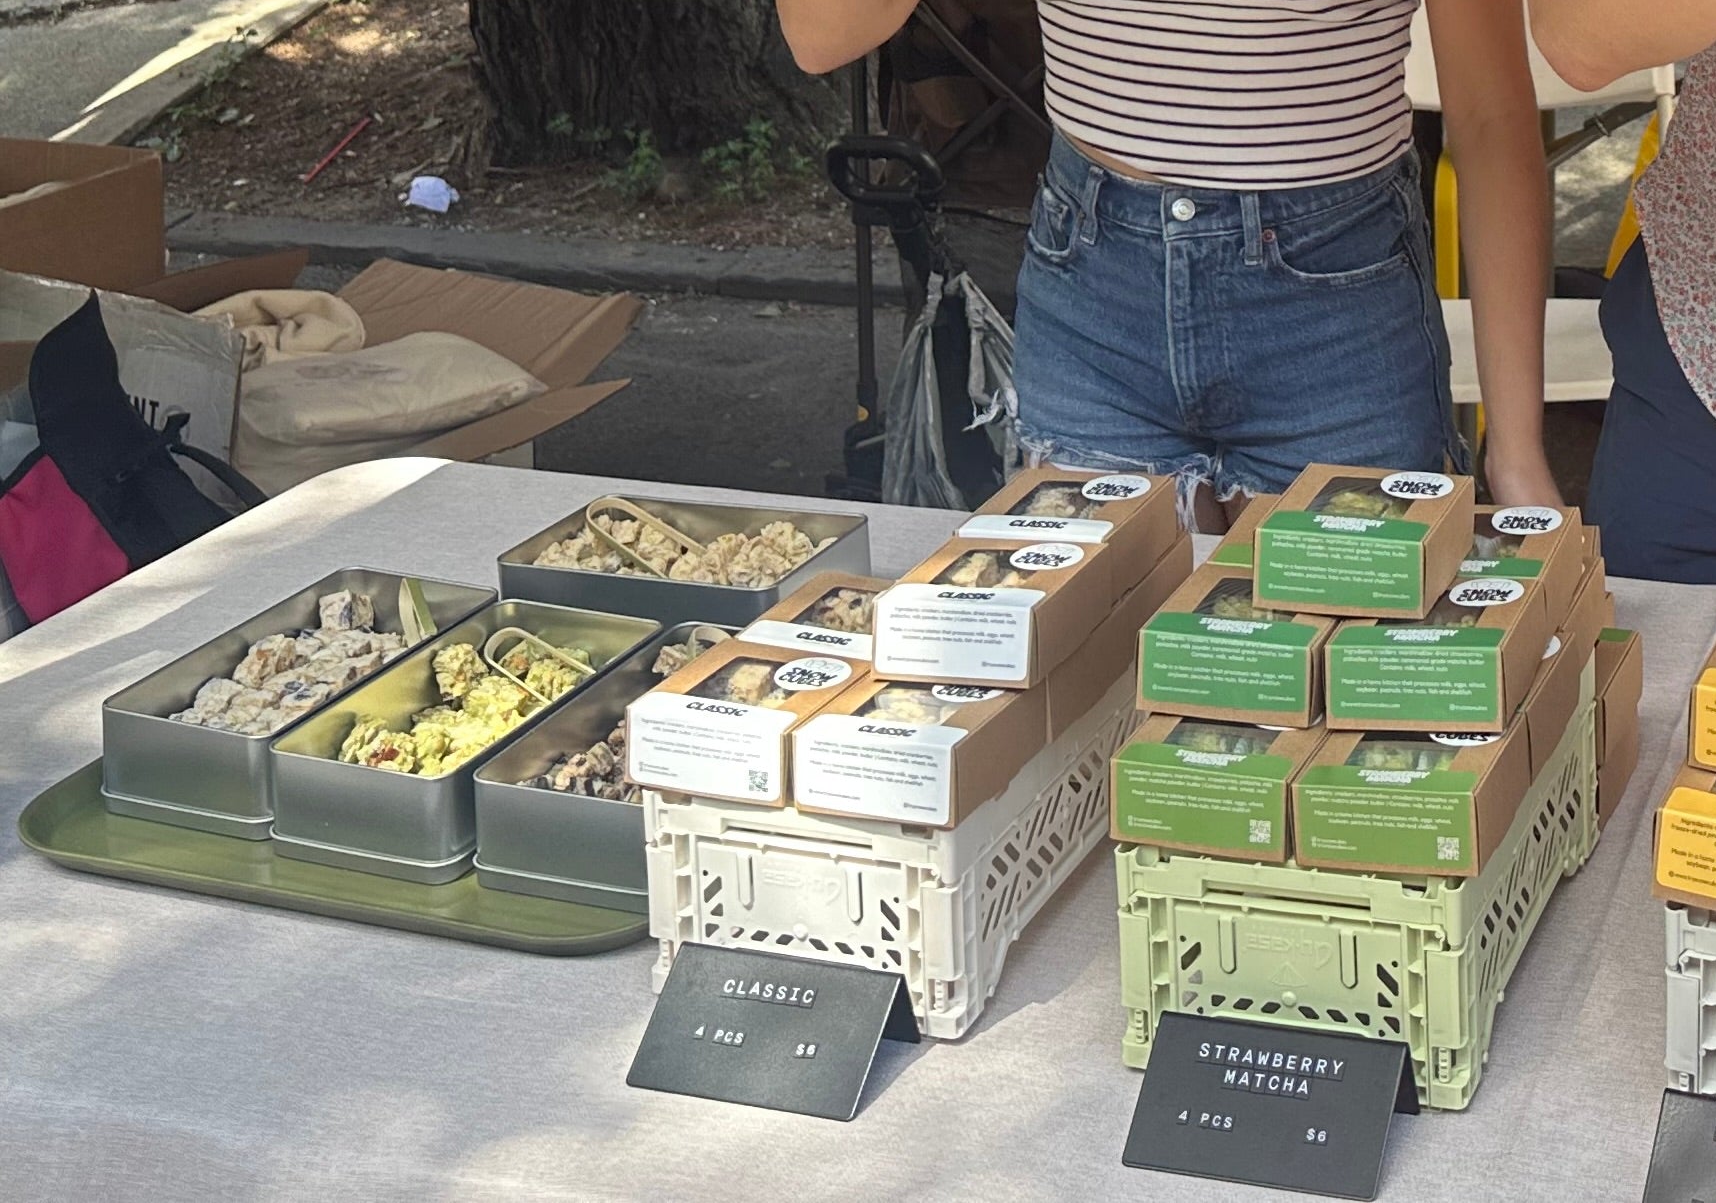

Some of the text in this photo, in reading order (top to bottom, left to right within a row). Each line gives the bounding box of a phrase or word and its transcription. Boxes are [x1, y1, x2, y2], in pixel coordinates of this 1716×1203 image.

[1388, 486, 1440, 496] CUBES
[1393, 480, 1444, 493] SNOW
[1009, 520, 1068, 530] CLASSIC
[1498, 521, 1548, 531] CUBES
[1504, 515, 1552, 528] SNOW
[938, 592, 996, 600] CLASSIC
[1456, 592, 1508, 602] CUBES
[1462, 587, 1514, 599] SNOW
[796, 632, 852, 646] CLASSIC
[686, 701, 749, 717] CLASSIC
[858, 724, 918, 738] CLASSIC
[723, 979, 815, 1004] CLASSIC
[694, 1026, 704, 1036] 4
[713, 1029, 744, 1044] PCS
[1199, 1042, 1344, 1076] STRAWBERRY
[1224, 1069, 1309, 1095] MATCHA
[1178, 1110, 1327, 1142] 4 PCS $6
